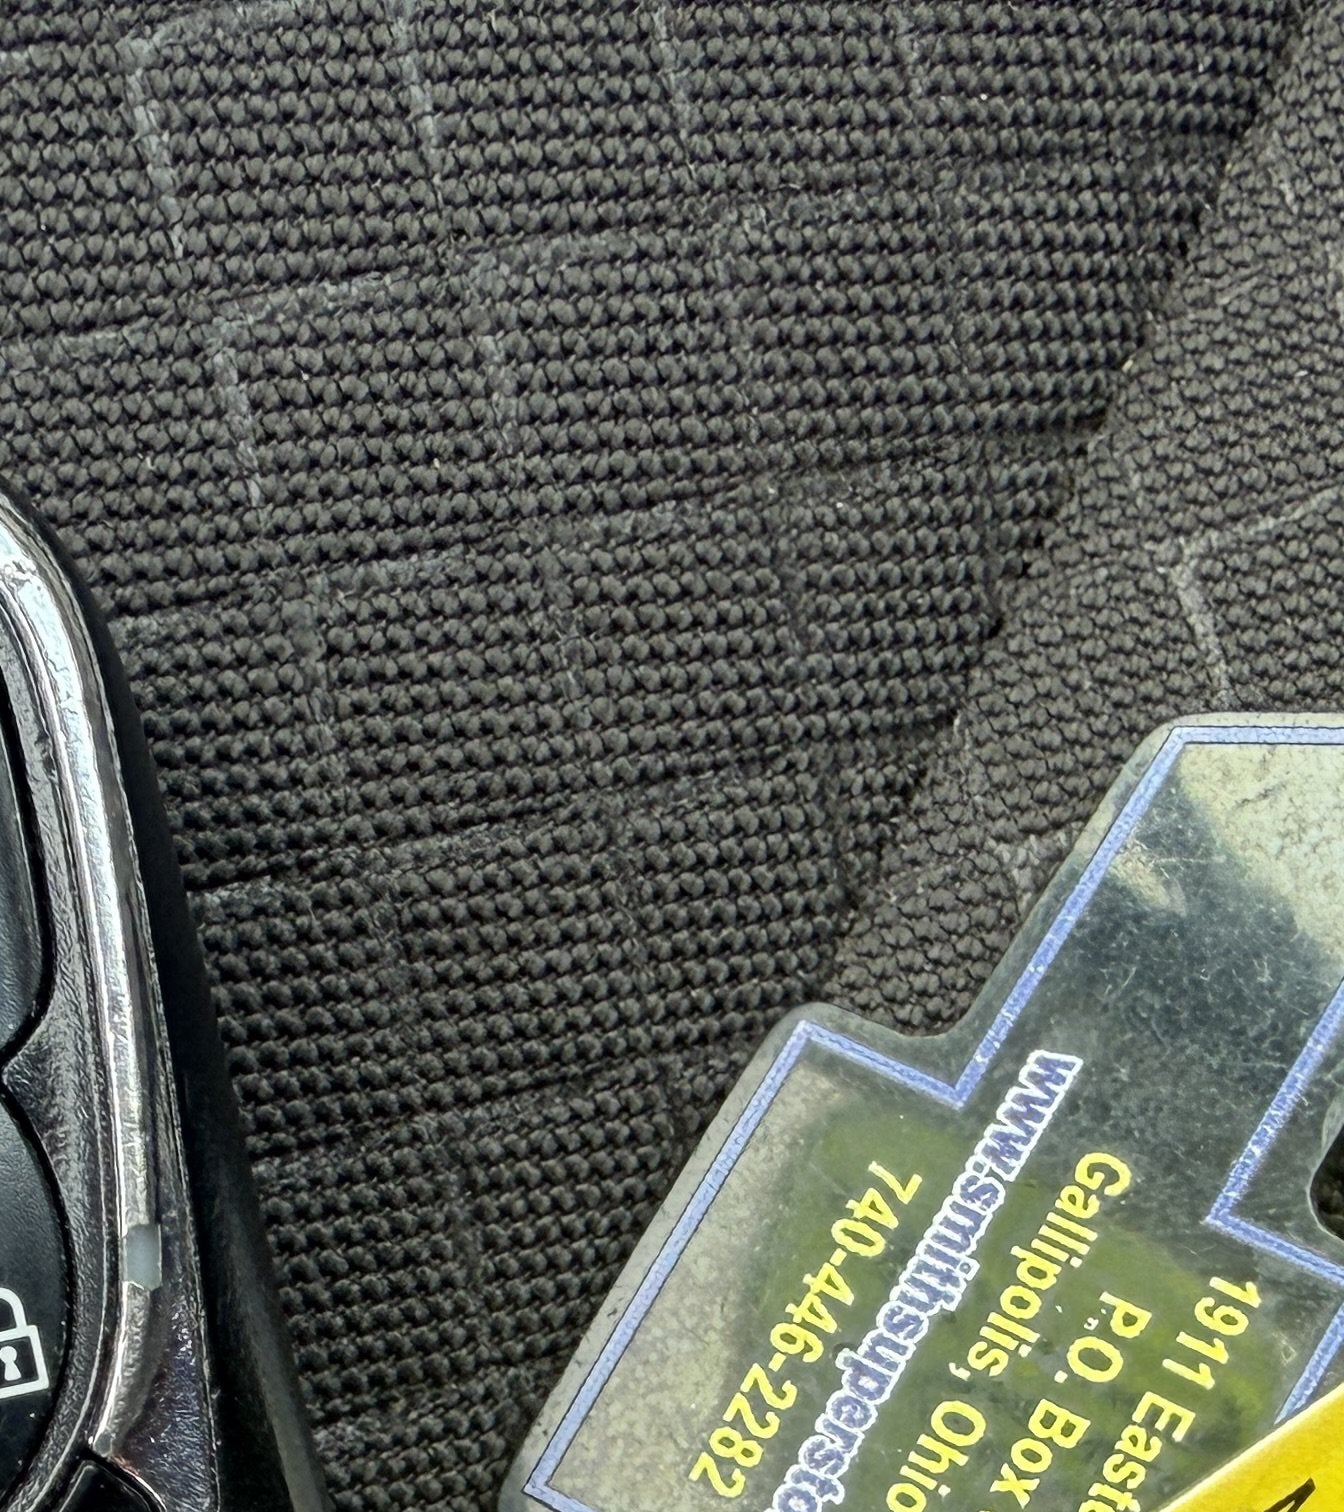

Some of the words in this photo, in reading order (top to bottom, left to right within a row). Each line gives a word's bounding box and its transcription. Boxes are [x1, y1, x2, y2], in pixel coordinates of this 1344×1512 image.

[946, 1150, 1133, 1382] Gallipolis,
[690, 1160, 924, 1498] 740-446-2282
[1053, 1290, 1154, 1386] P.O.
[1161, 1276, 1261, 1391] 1911
[992, 1399, 1091, 1505] Box
